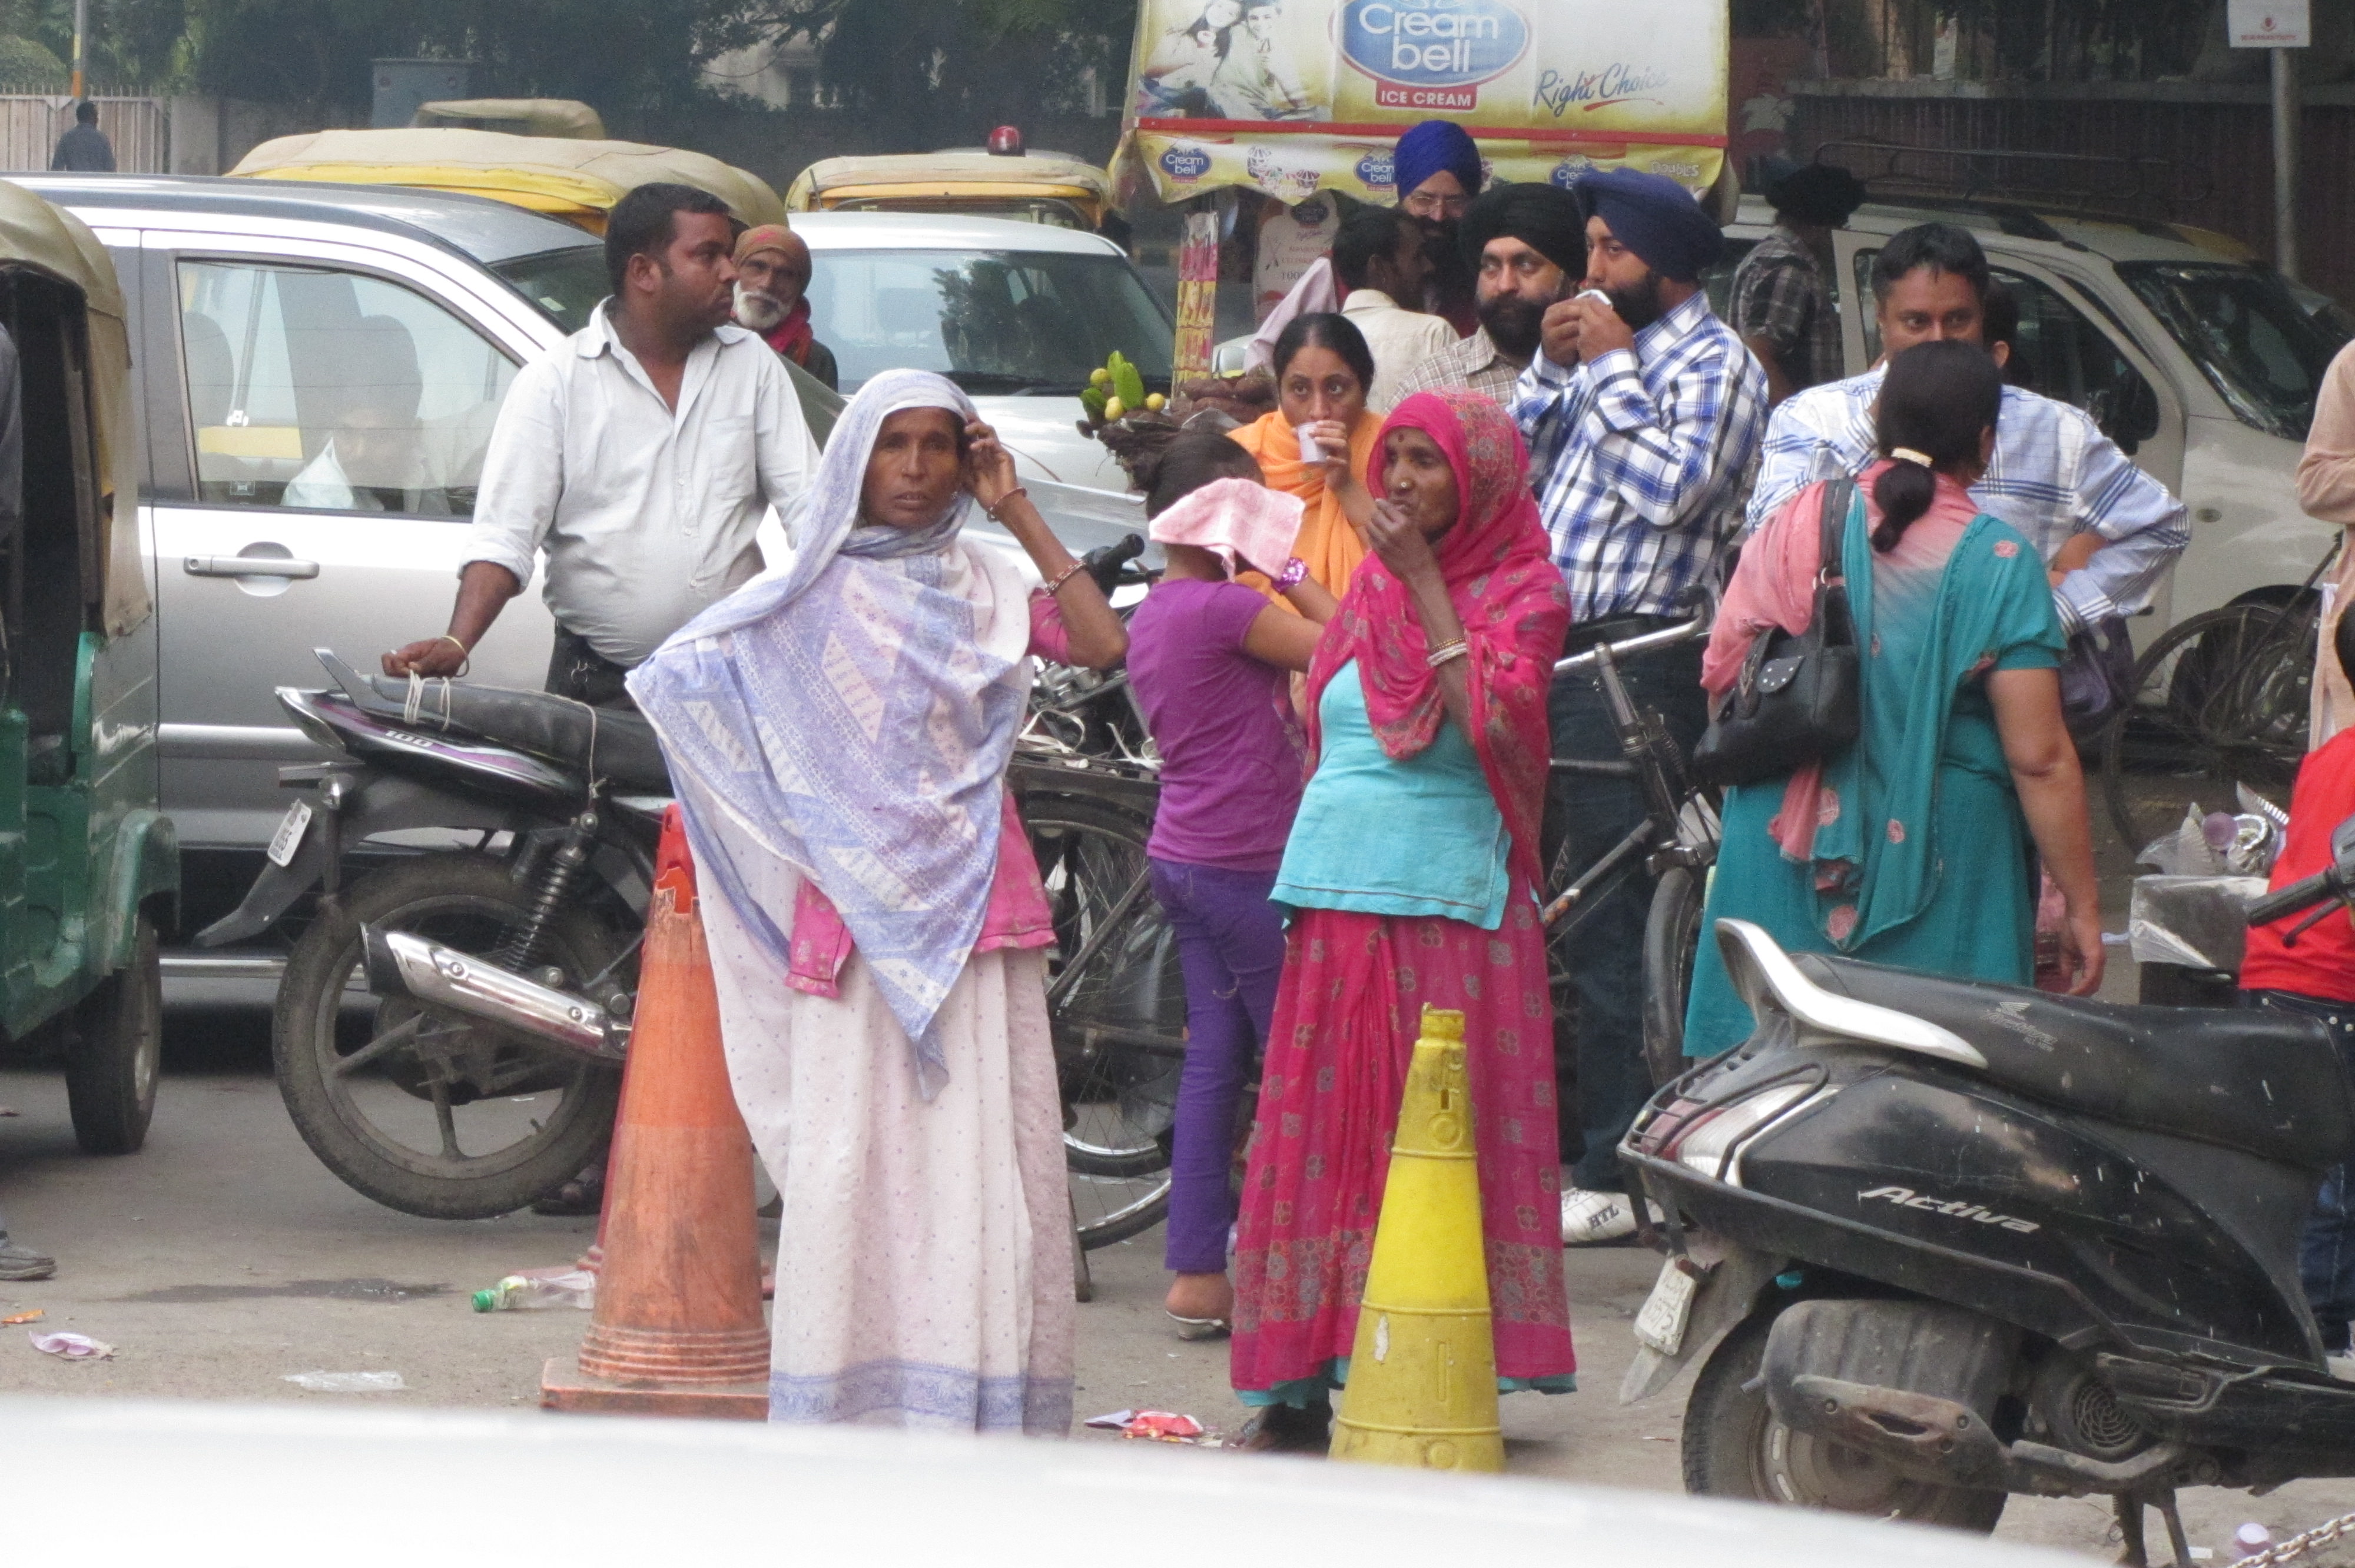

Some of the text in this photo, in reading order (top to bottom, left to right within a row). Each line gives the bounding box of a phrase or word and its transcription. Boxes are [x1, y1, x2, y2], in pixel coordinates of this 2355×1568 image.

[1359, 4, 1498, 40] Cream
[1391, 36, 1471, 72] bell
[1381, 90, 1471, 107] ICE CREAM
[1533, 62, 1671, 117] Right Choice
[1165, 154, 1204, 166] Cream
[1174, 165, 1197, 175] bell
[1370, 172, 1392, 183] bell
[385, 730, 434, 748] 100
[1858, 1185, 2041, 1234] Activa
